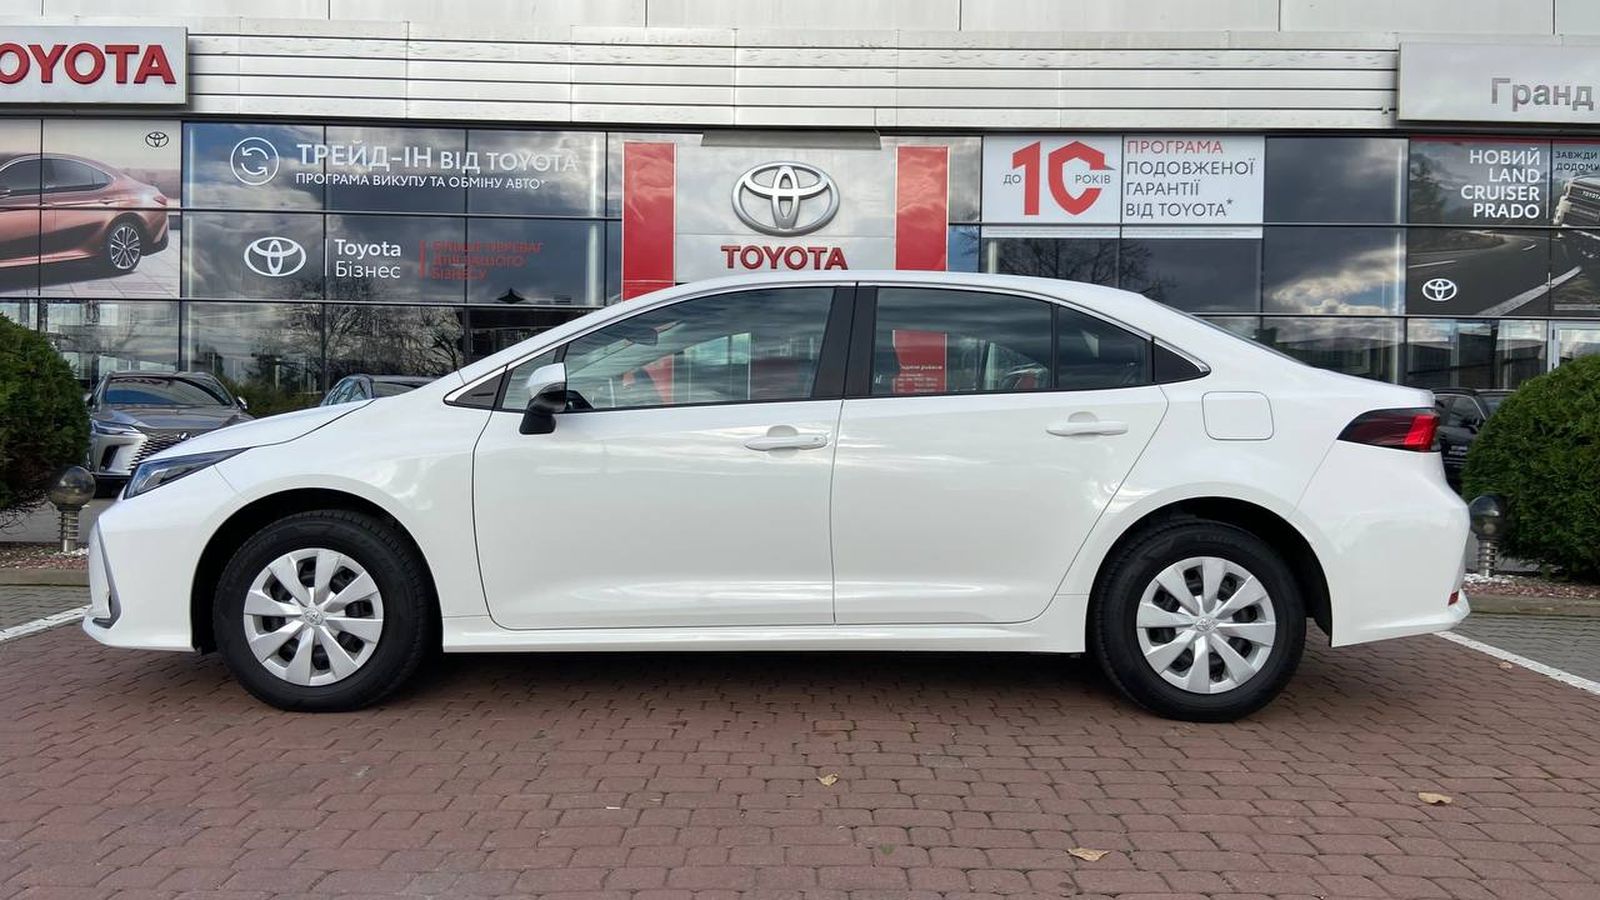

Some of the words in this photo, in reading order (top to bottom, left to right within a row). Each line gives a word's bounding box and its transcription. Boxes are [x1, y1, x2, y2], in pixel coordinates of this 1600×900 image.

[1491, 77, 1594, 112] Гранд
[1127, 140, 1224, 154] ПРОГРАМА
[297, 140, 432, 172] ТРЕЙД-ІН
[440, 151, 480, 174] ВІД
[486, 152, 578, 172] TOYOTA
[1470, 147, 1540, 165] НОВИЙ
[1555, 151, 1597, 160] ЗАВЖДИ
[1127, 158, 1256, 177] ПОДОВЖЕНОЇ
[1489, 168, 1540, 183] LAND
[296, 173, 370, 185] ПРОГРАМА
[373, 175, 427, 187] ВИКУПУ
[430, 176, 446, 187] ТА
[449, 176, 503, 188] ОБМІНУ
[1003, 174, 1022, 184] ДО
[1075, 174, 1111, 184] РОКІВ
[1126, 179, 1200, 196] ГАРАНТІЇ
[1461, 185, 1540, 201] CRUISER
[1126, 203, 1153, 219] ВІД
[1473, 203, 1540, 219] PRADO
[335, 239, 401, 260] Toyota
[721, 245, 848, 270] TOYOTA
[335, 261, 401, 278] Бізнес
